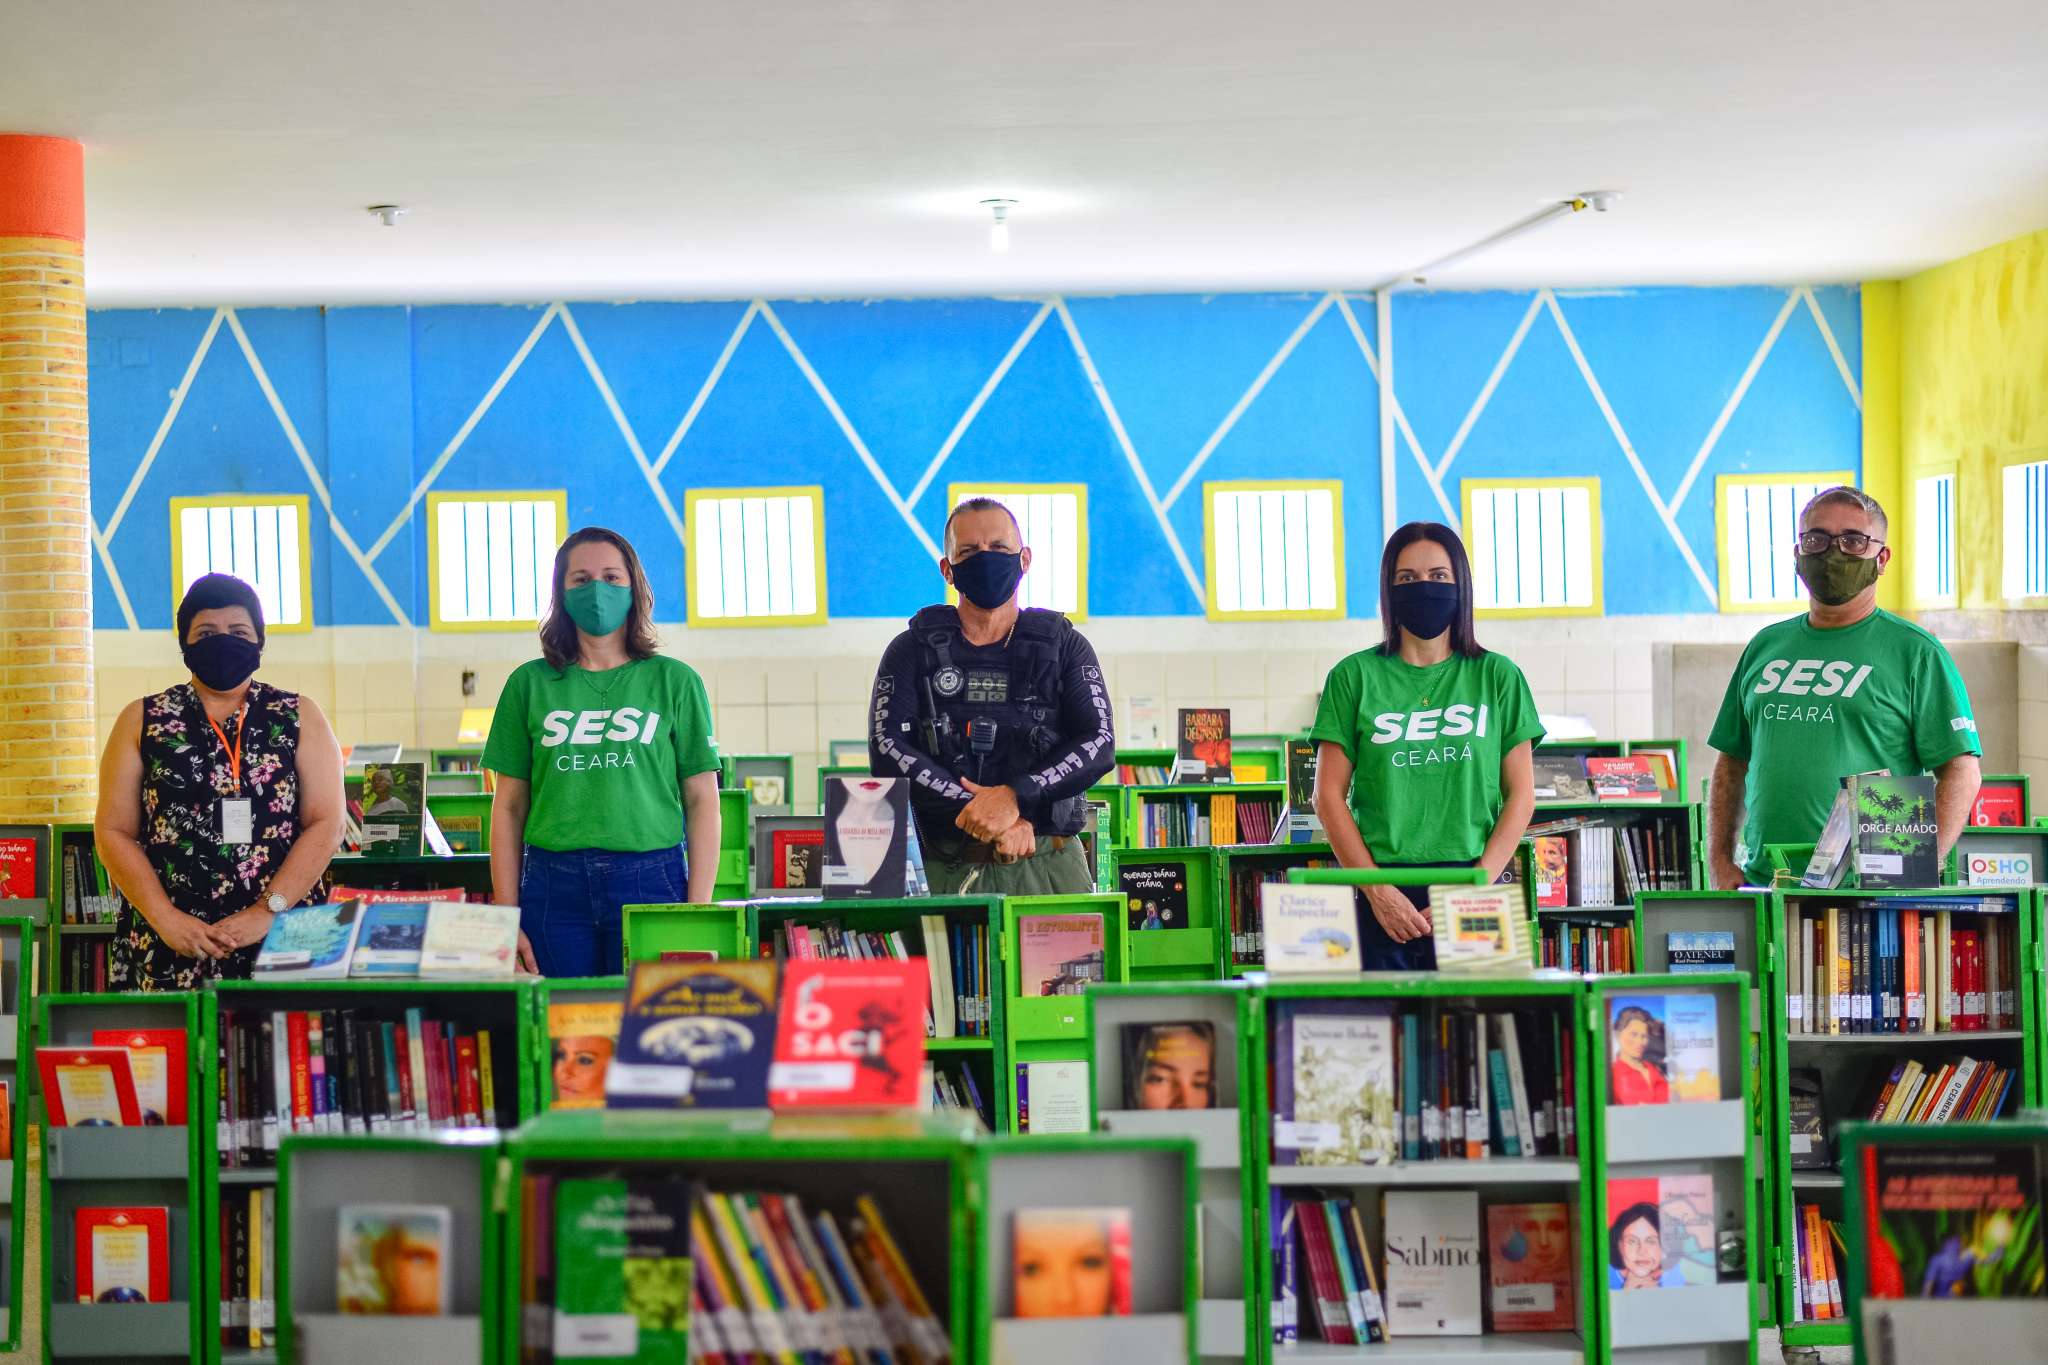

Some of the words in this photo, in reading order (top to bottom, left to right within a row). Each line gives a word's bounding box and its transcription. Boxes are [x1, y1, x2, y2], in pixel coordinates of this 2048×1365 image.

[1753, 659, 1874, 698] SESI
[1185, 713, 1223, 726] BARBARA
[1763, 703, 1835, 723] CEARÁ
[540, 707, 661, 747] SESI
[1370, 703, 1488, 745] SESI
[1185, 726, 1224, 741] DELINSKY
[557, 749, 636, 771] CEARÁ
[1391, 741, 1472, 767] CEARÁ
[1858, 823, 1892, 834] JORGE
[1894, 823, 1938, 834] AMADO
[1122, 871, 1152, 880] QUERIDO
[1154, 868, 1177, 878] DIÁRIO
[1971, 858, 2029, 874] OSHO
[1976, 876, 2026, 886] Aprendendo
[372, 893, 448, 903] Minotauro
[1674, 951, 1682, 959] O
[1684, 950, 1726, 959] ATENEU
[791, 1028, 883, 1058] SACI
[1954, 1082, 1962, 1090] O
[236, 1211, 244, 1296] CAPOT
[1386, 1235, 1483, 1267] Sabino
